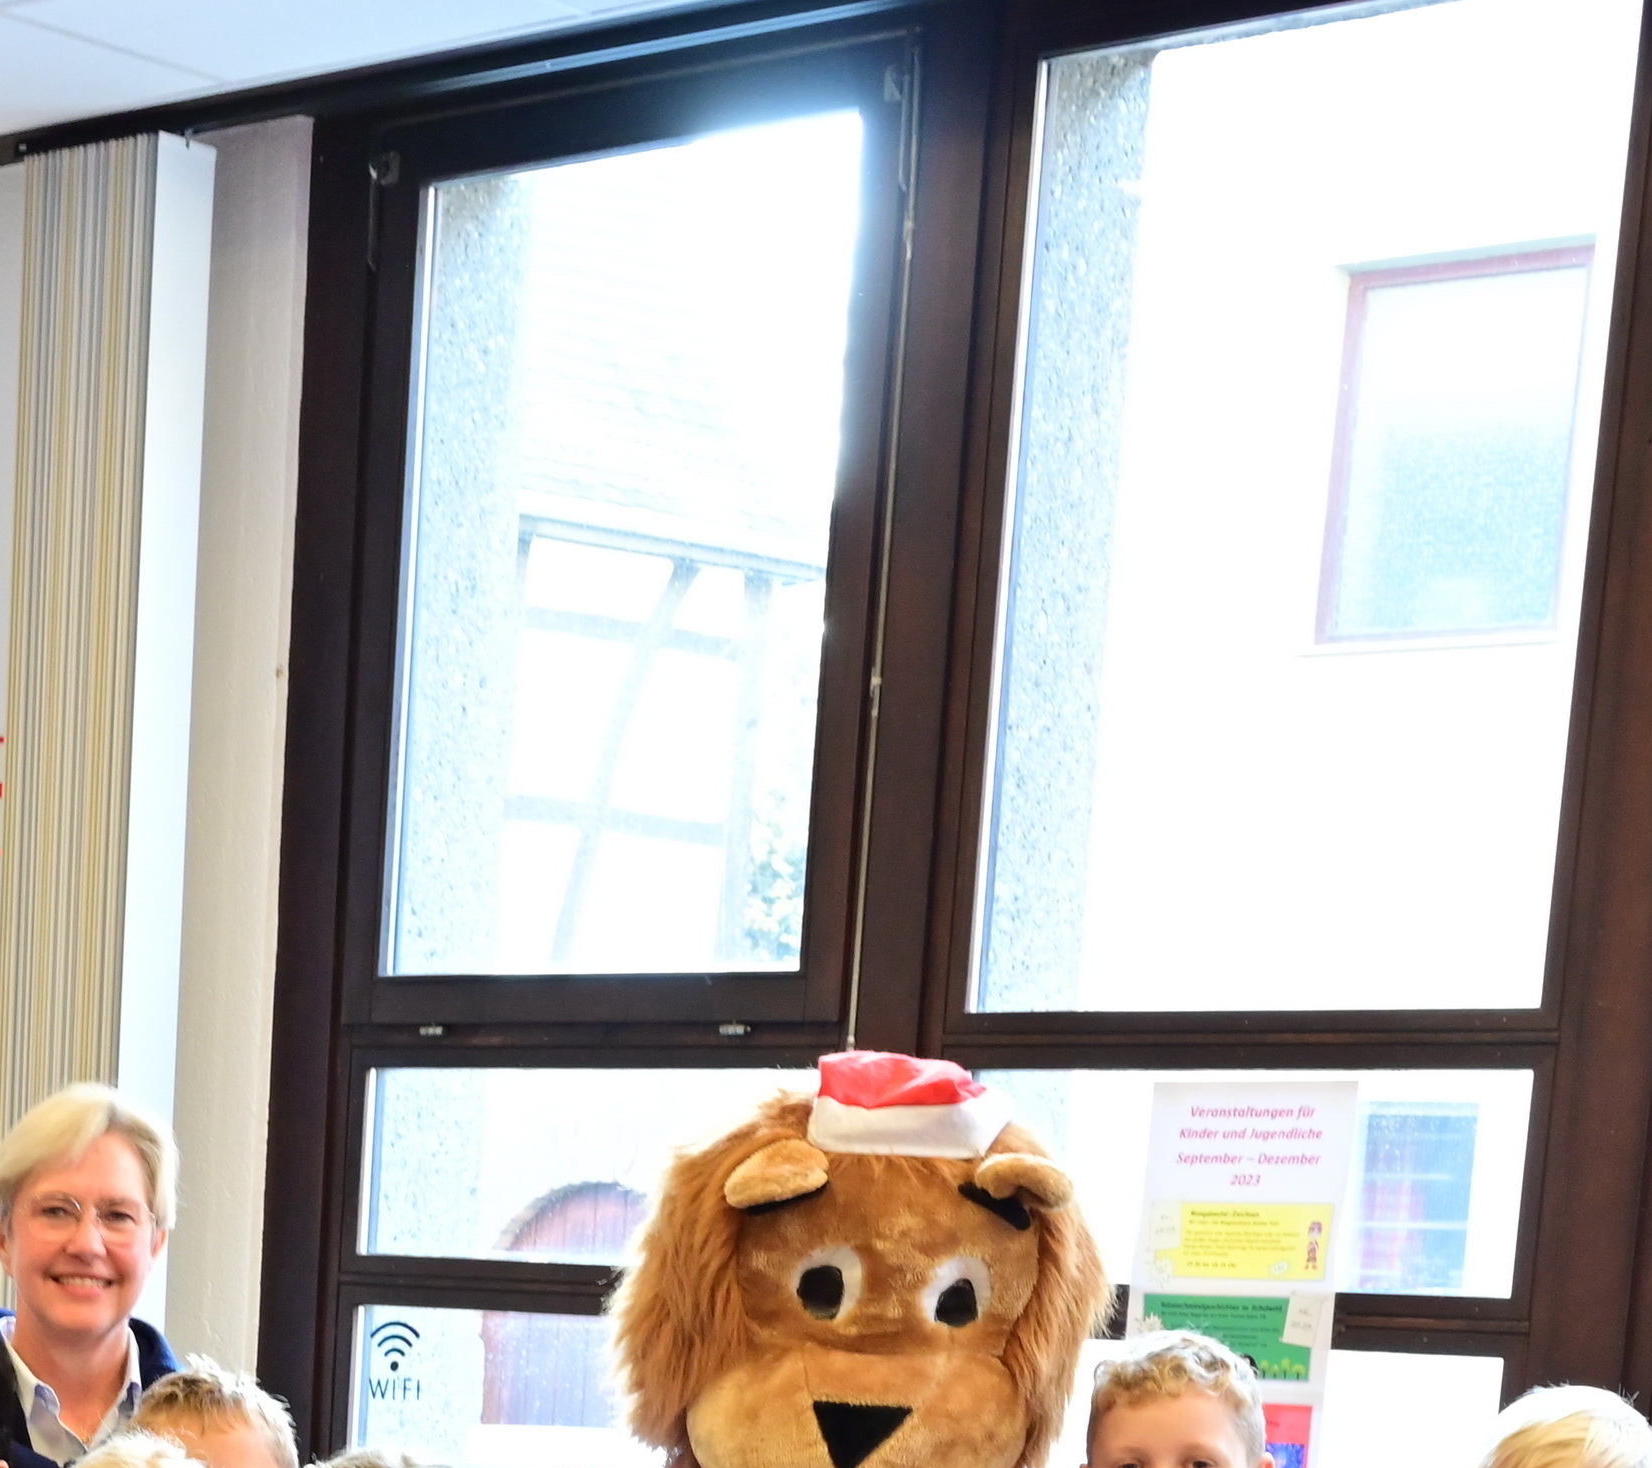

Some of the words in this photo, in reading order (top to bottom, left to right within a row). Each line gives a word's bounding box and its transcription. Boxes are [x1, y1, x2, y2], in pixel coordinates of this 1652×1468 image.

[1190, 1106, 1293, 1120] Veranstaltungen
[1296, 1105, 1316, 1120] für
[1179, 1128, 1219, 1140] Kinder
[1222, 1128, 1247, 1140] und
[1249, 1128, 1323, 1141] Jugendliche
[1176, 1153, 1243, 1167] September
[1257, 1153, 1322, 1165] Dezember
[1230, 1174, 1261, 1187] 2023
[368, 1377, 420, 1401] WIFI
